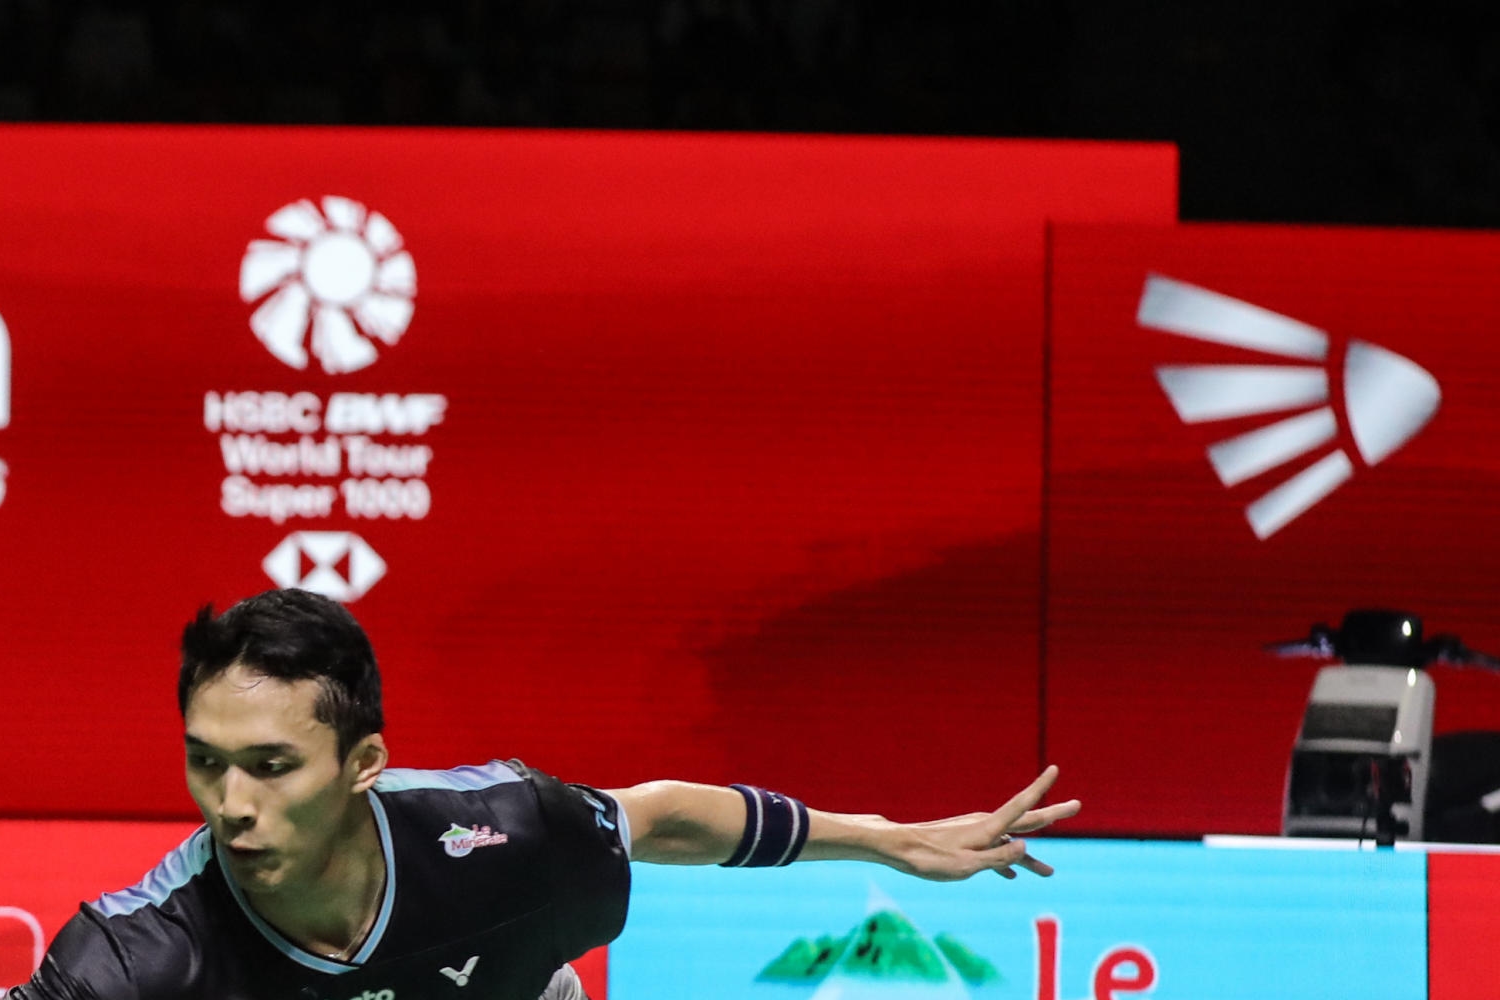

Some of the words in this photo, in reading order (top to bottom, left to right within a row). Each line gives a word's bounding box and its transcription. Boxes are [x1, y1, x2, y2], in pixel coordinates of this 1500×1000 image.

[220, 434, 340, 475] World
[342, 436, 433, 477] Tour
[220, 476, 336, 524] Super
[341, 478, 431, 520] 1000
